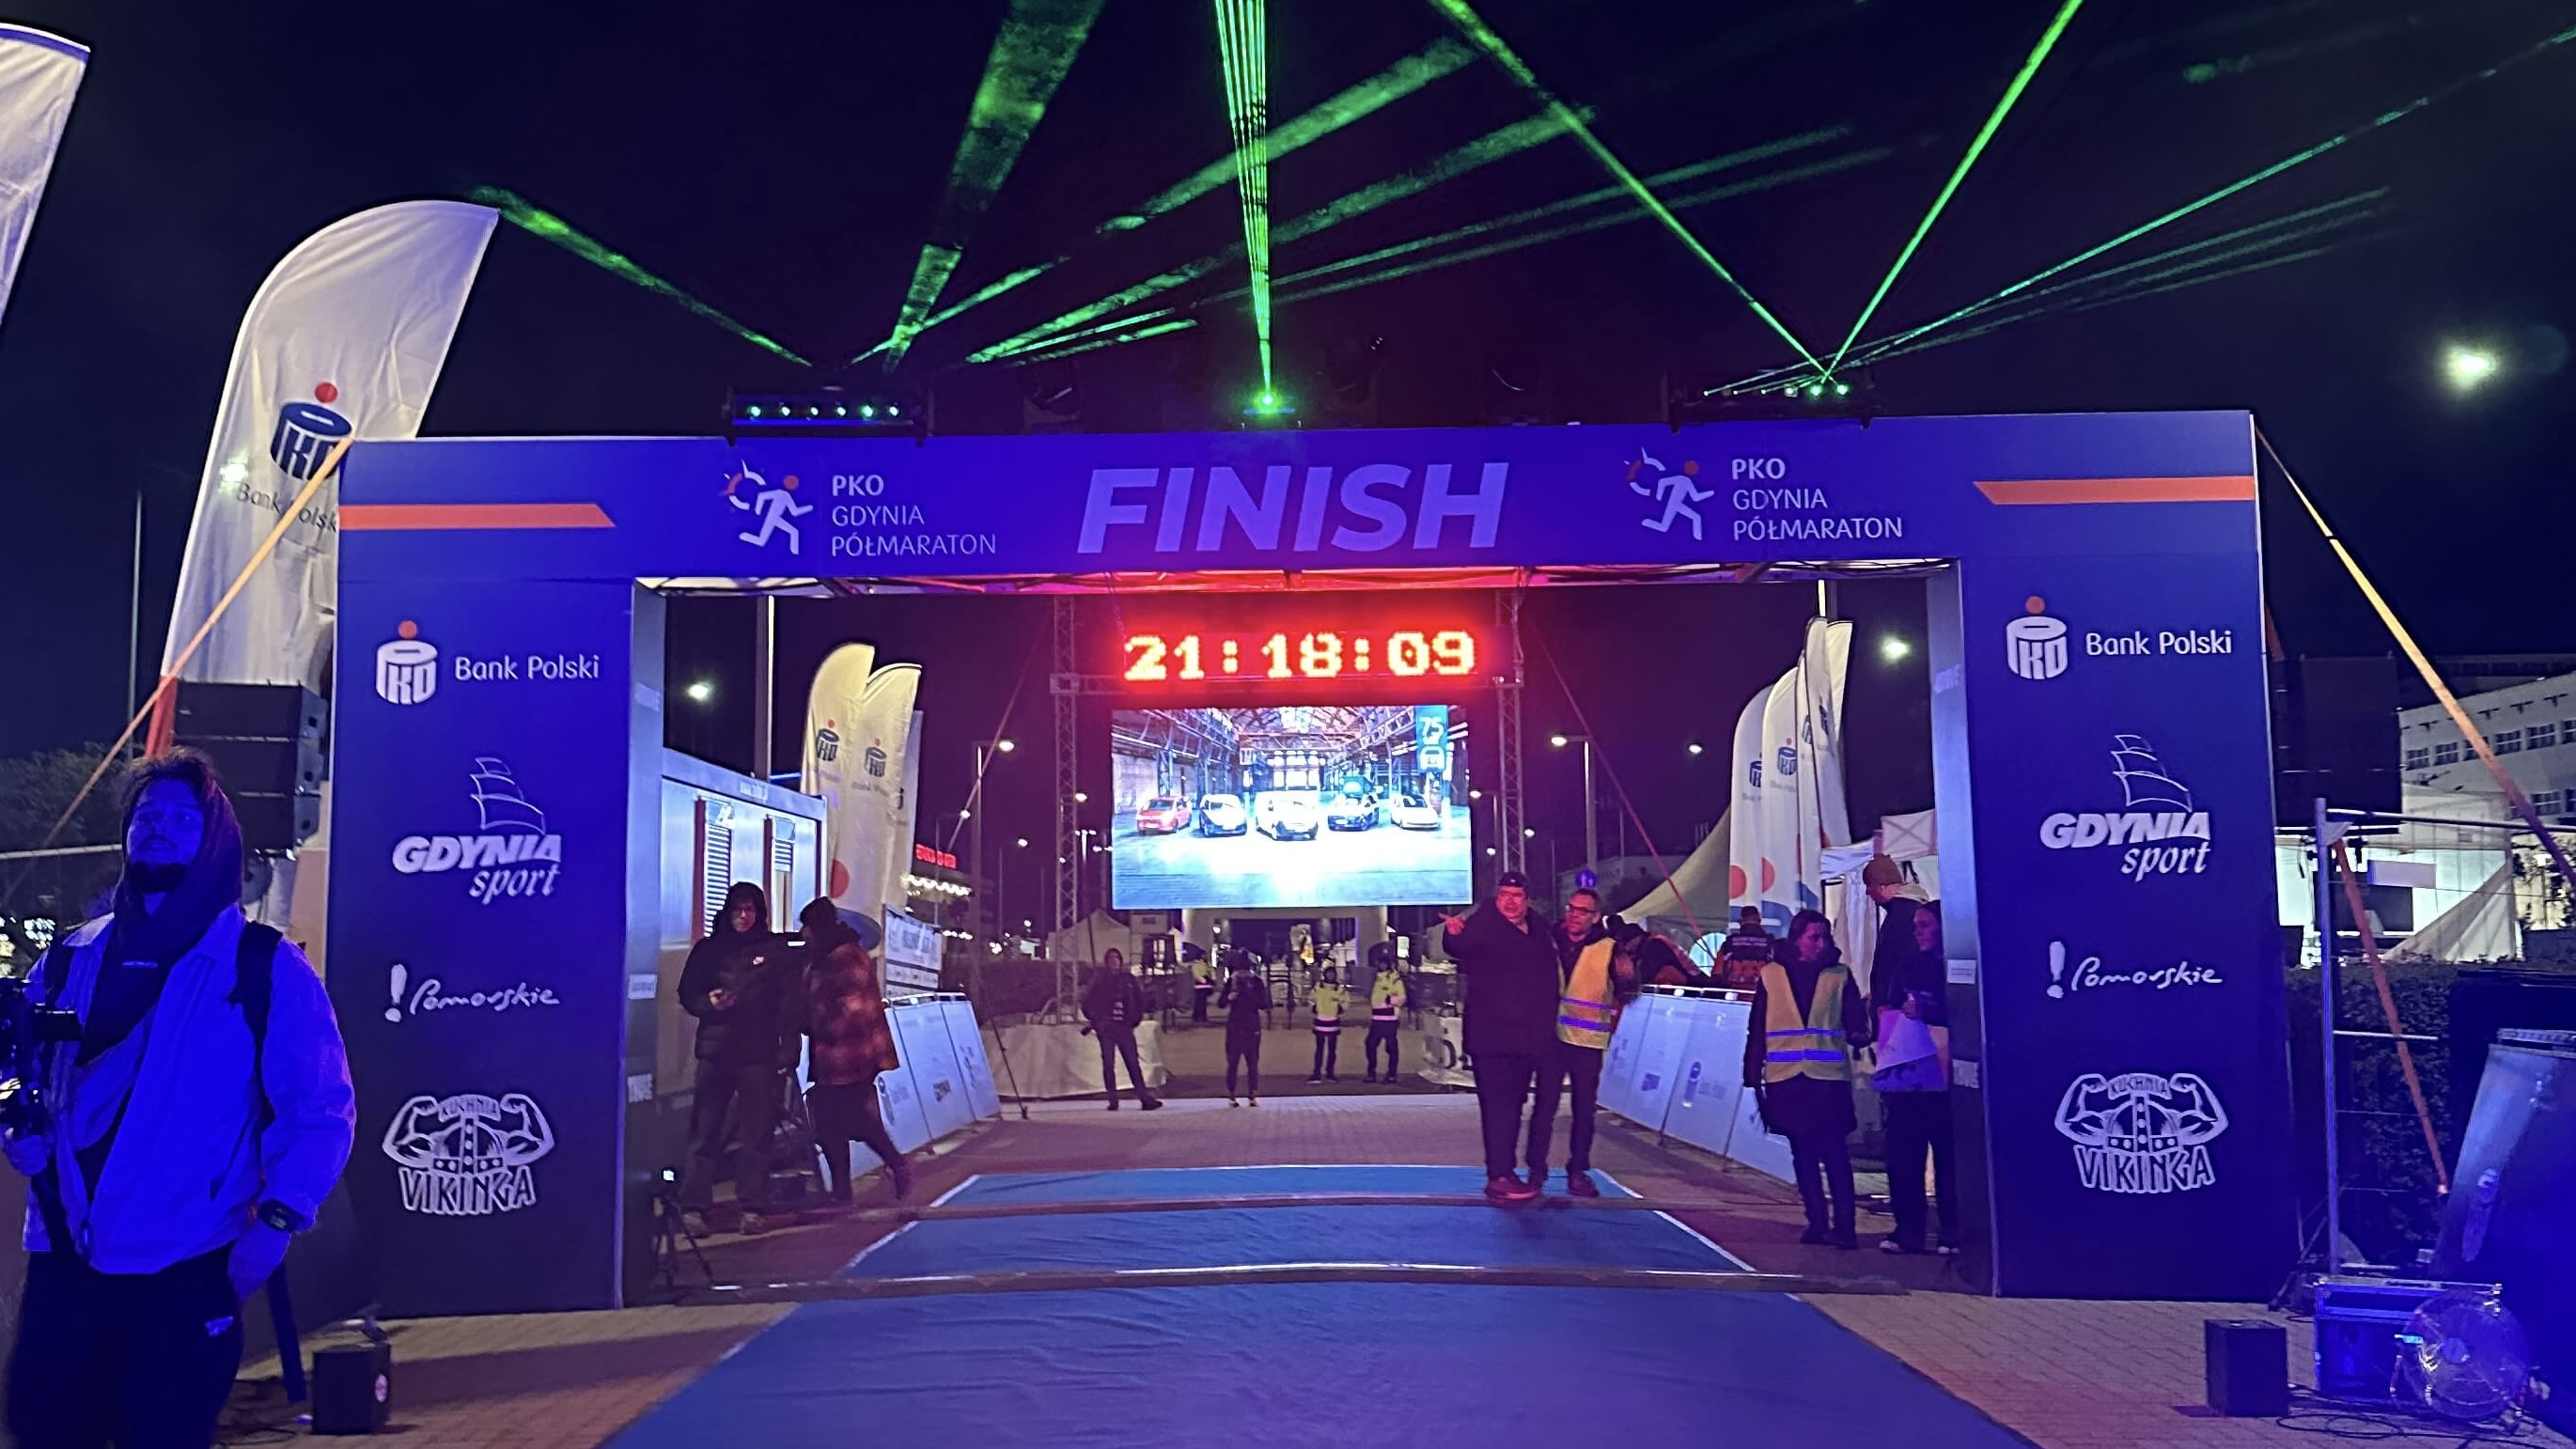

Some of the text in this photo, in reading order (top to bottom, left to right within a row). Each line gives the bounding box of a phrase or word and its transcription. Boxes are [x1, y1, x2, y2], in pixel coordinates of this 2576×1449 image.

[1731, 458, 1786, 480] PKO
[237, 483, 283, 518] Bank
[832, 475, 884, 496] PKO
[1732, 488, 1828, 509] GDYNIA
[832, 505, 925, 526] GDYNIA
[1077, 462, 1509, 553] FINISH
[1733, 516, 1902, 540] PÓŁMARATON
[832, 532, 996, 557] PÓŁMARATON
[2084, 631, 2151, 656] Bank
[2159, 630, 2232, 655] Polski
[454, 654, 518, 681] Bank
[527, 653, 600, 680] Polski
[2039, 812, 2210, 849] GDYNIA
[392, 834, 561, 874] GDYNIA
[2120, 842, 2211, 881] sport
[469, 864, 561, 905] sport
[2073, 1145, 2216, 1193] VIKINGA
[398, 1165, 537, 1215] VIKINGA
